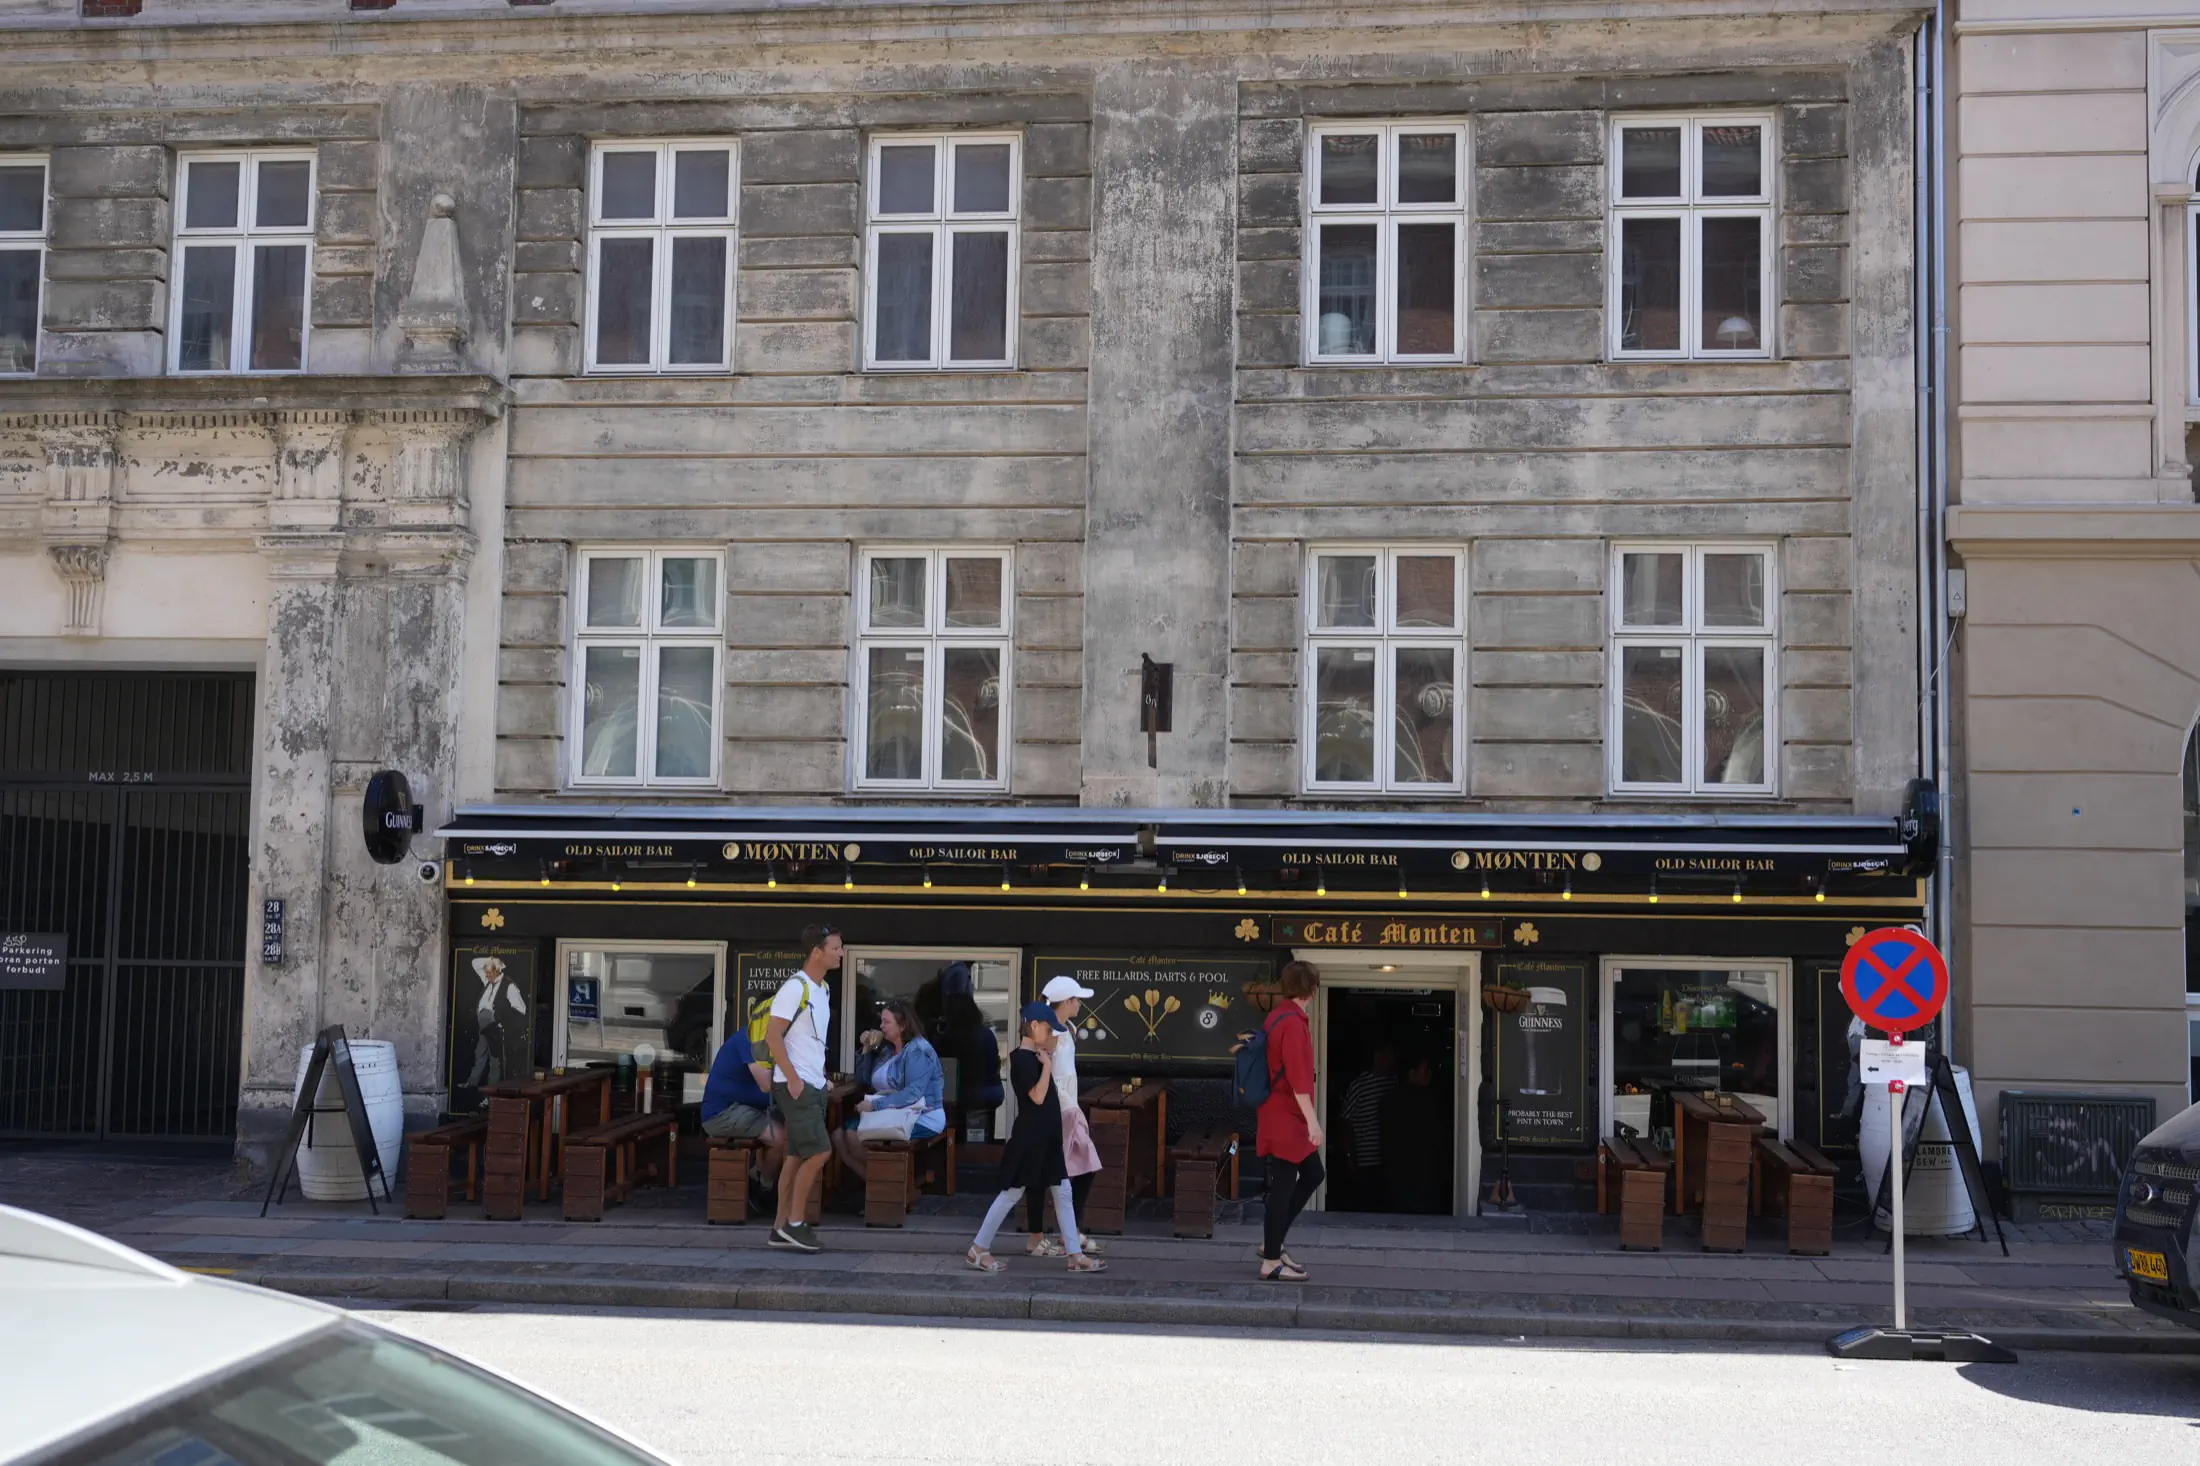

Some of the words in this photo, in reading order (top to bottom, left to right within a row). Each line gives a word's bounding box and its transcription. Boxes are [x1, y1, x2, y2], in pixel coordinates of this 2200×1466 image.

[88, 771, 115, 782] MAX
[123, 772, 140, 783] 2,5
[143, 772, 153, 782] M
[385, 811, 413, 829] GUINNE
[565, 845, 592, 856] OLD
[596, 845, 642, 856] SAILOR
[646, 845, 673, 857] BAR
[744, 843, 840, 861] MØNTEN
[909, 848, 935, 859] OLD
[938, 847, 986, 860] SAILOR
[991, 848, 1017, 860] BAR
[1282, 852, 1311, 865] OLD
[1315, 852, 1365, 865] SAILOR
[1369, 853, 1398, 865] BAR
[1474, 851, 1577, 871] MØNTEN
[1655, 857, 1685, 870] OLD
[1688, 858, 1741, 870] SAILOR
[1745, 858, 1775, 871] BAR
[266, 900, 280, 913] 28
[264, 922, 281, 934] 28A
[1303, 920, 1362, 945] Café
[1380, 922, 1476, 945] Mønten
[2, 946, 53, 956] Parkering
[264, 943, 281, 956] 28B
[25, 957, 60, 965] porten
[6, 964, 46, 974] forbudt
[749, 968, 771, 978] LIVE
[1076, 970, 1100, 981] FREE
[1102, 971, 1151, 982] BILLARDS,
[1154, 971, 1187, 982] DARTS
[1189, 973, 1196, 982] &
[1199, 972, 1229, 983] POOL
[747, 980, 778, 990] EVERY
[1203, 1012, 1213, 1025] 8
[1519, 1015, 1563, 1030] GUINNESS
[1508, 1109, 1540, 1118] PROBABLY
[1542, 1110, 1556, 1118] THE
[1557, 1111, 1574, 1119] BEST
